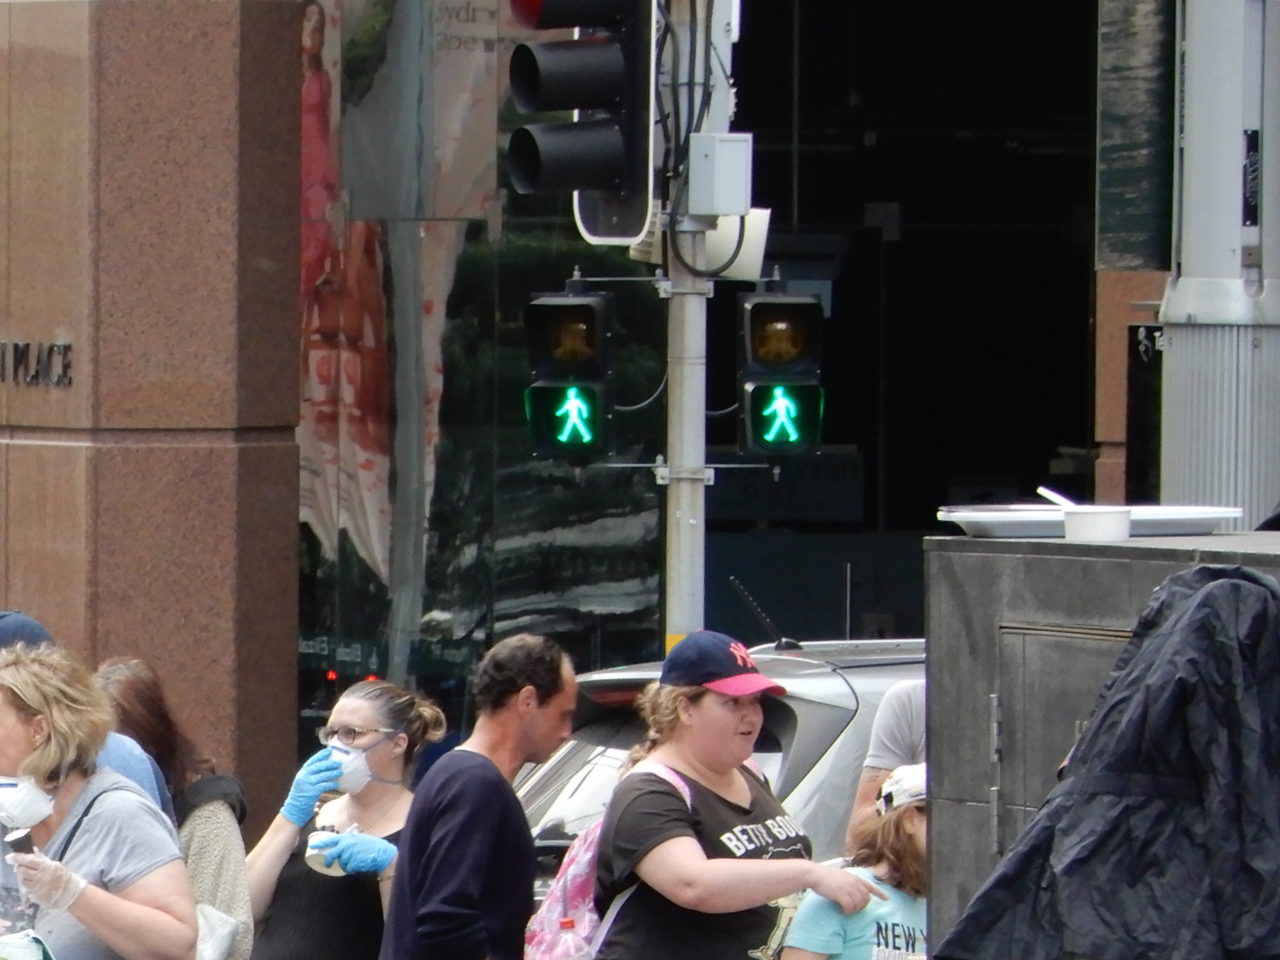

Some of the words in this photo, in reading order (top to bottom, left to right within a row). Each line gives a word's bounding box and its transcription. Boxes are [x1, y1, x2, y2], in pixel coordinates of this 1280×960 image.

[13, 341, 72, 387] PLACE
[720, 824, 773, 857] BETTY
[876, 921, 916, 954] NEW
